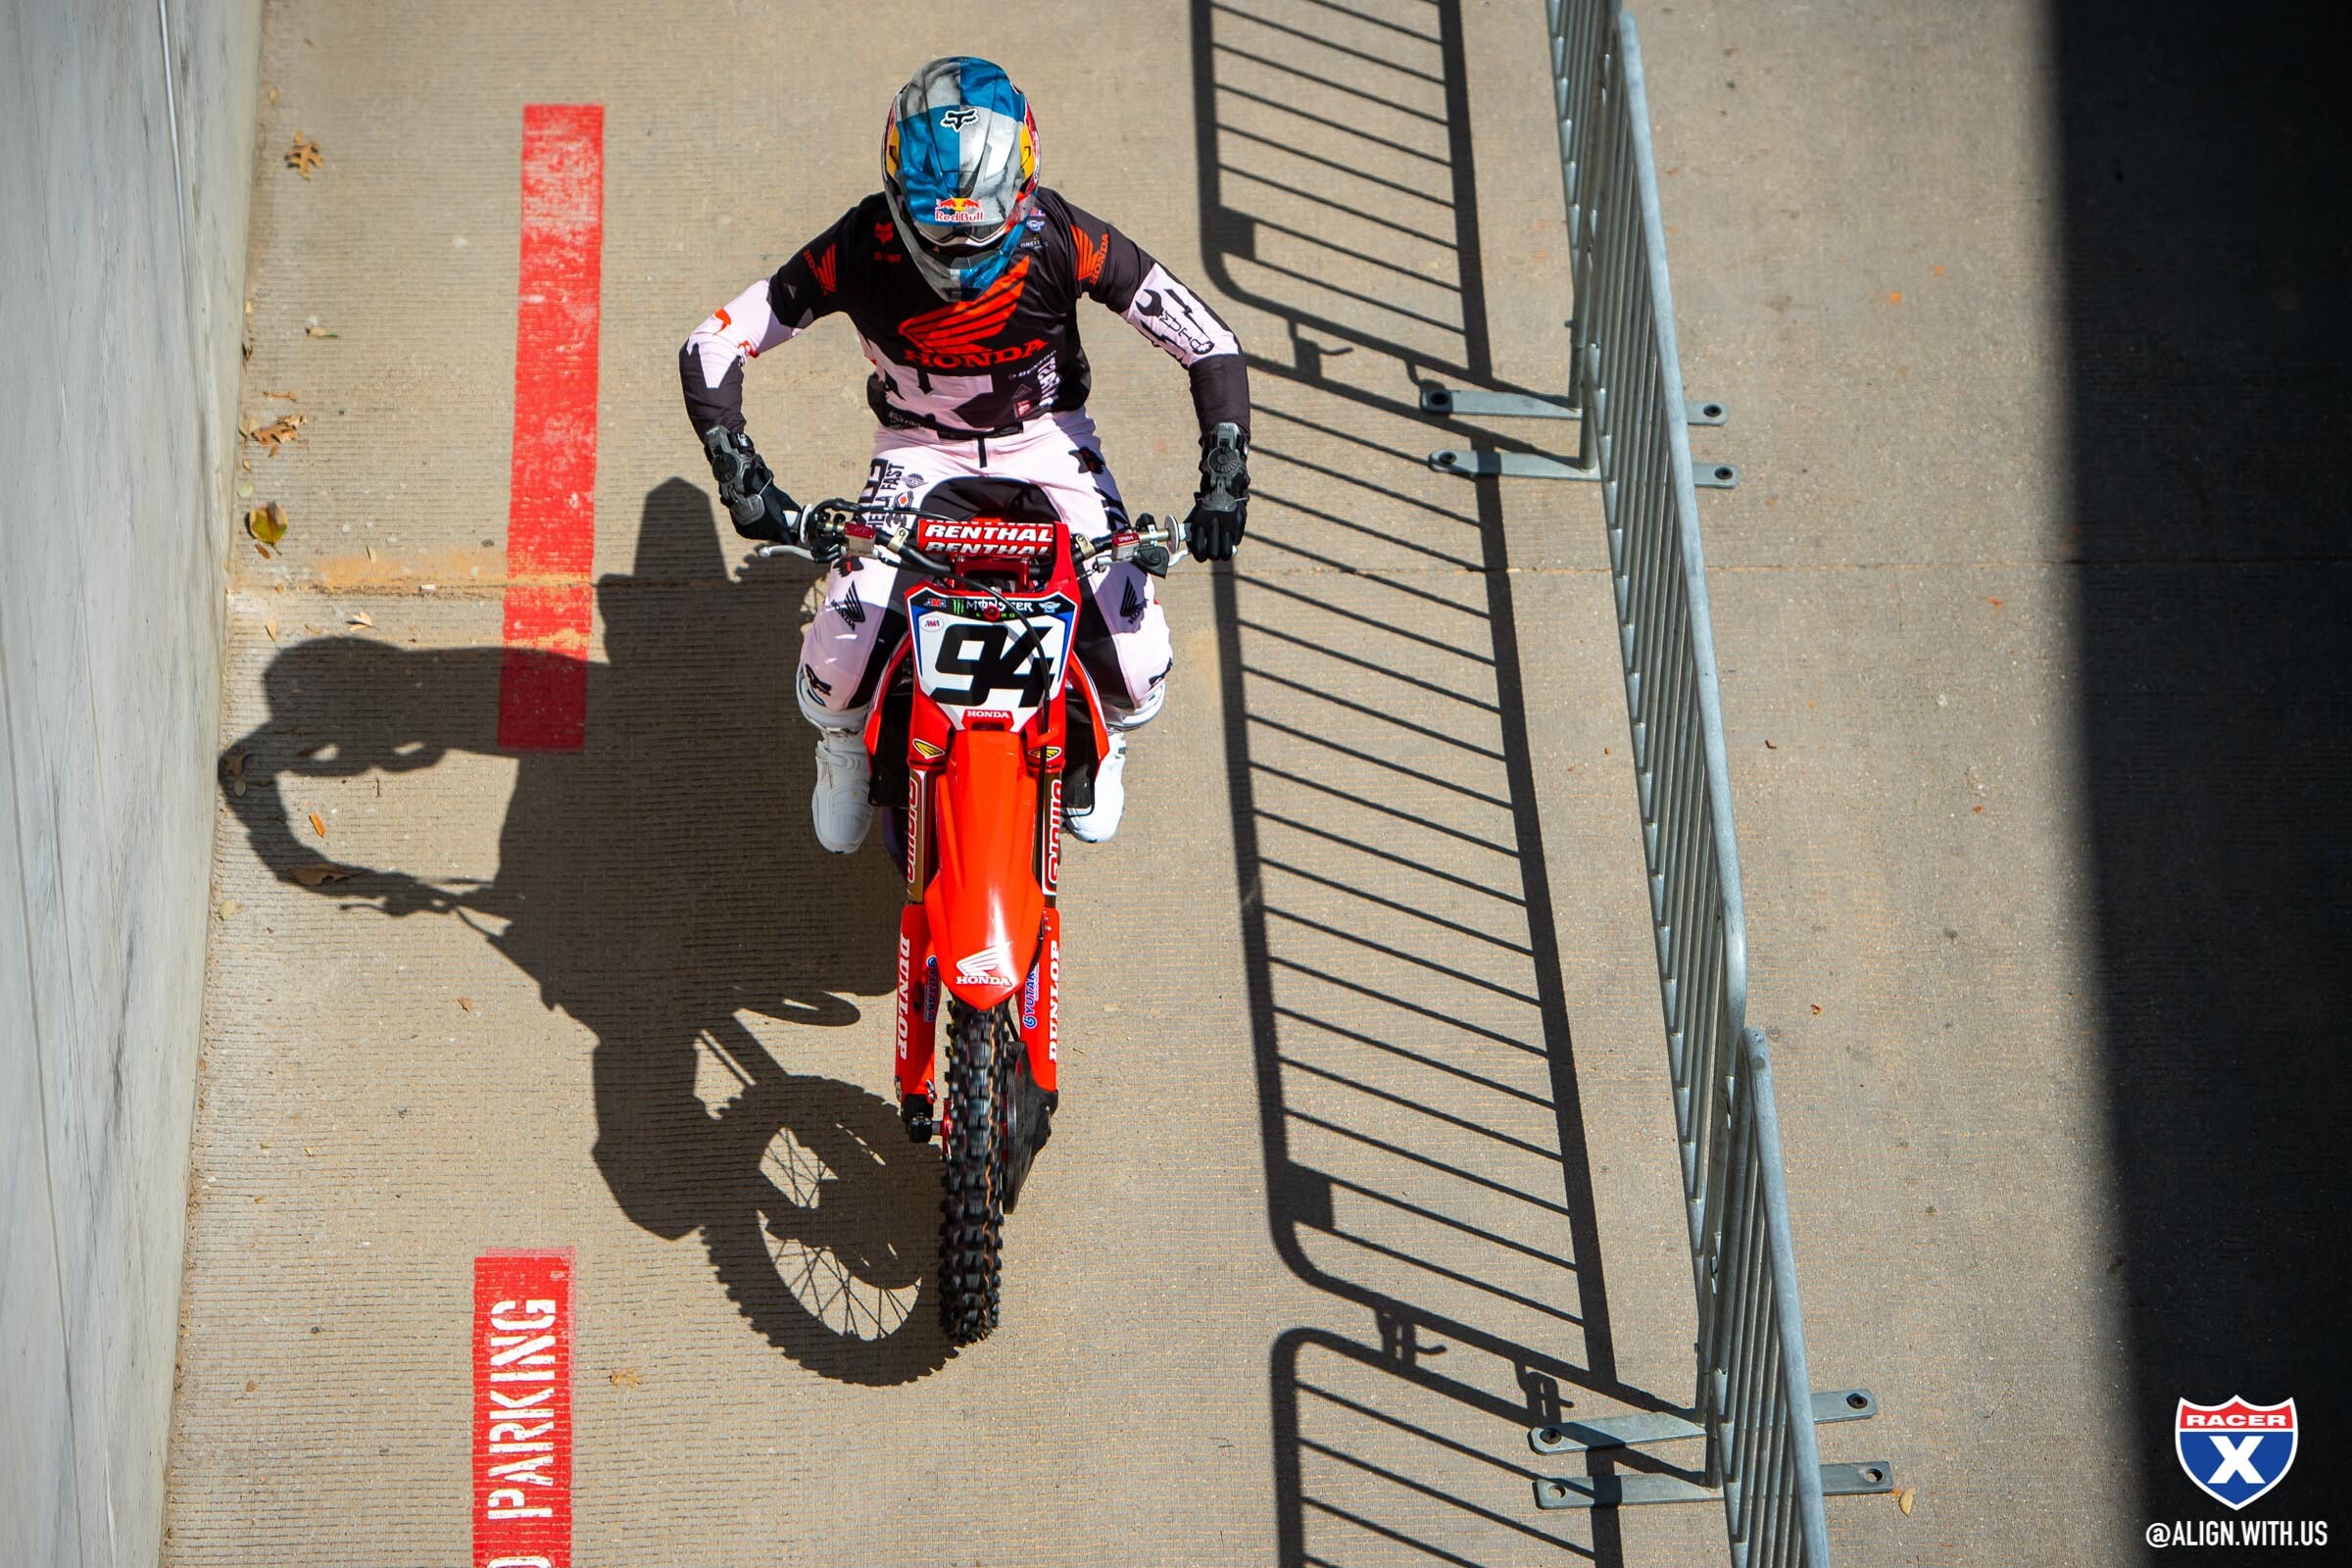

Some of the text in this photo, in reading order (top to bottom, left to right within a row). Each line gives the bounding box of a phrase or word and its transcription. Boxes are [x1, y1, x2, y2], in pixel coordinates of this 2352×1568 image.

[935, 210, 984, 222] Red Bull
[1089, 233, 1108, 285] HONDA
[904, 338, 1049, 368] HONDA
[880, 463, 905, 490] FAST
[925, 524, 1054, 542] RENTHAL
[929, 623, 1055, 708] 94
[966, 710, 1010, 718] HONDA
[898, 933, 910, 1060] DUNLOP
[956, 976, 1012, 987] HONDA
[1049, 940, 1060, 1063] DUNLOP
[488, 1298, 556, 1520] PARKING
